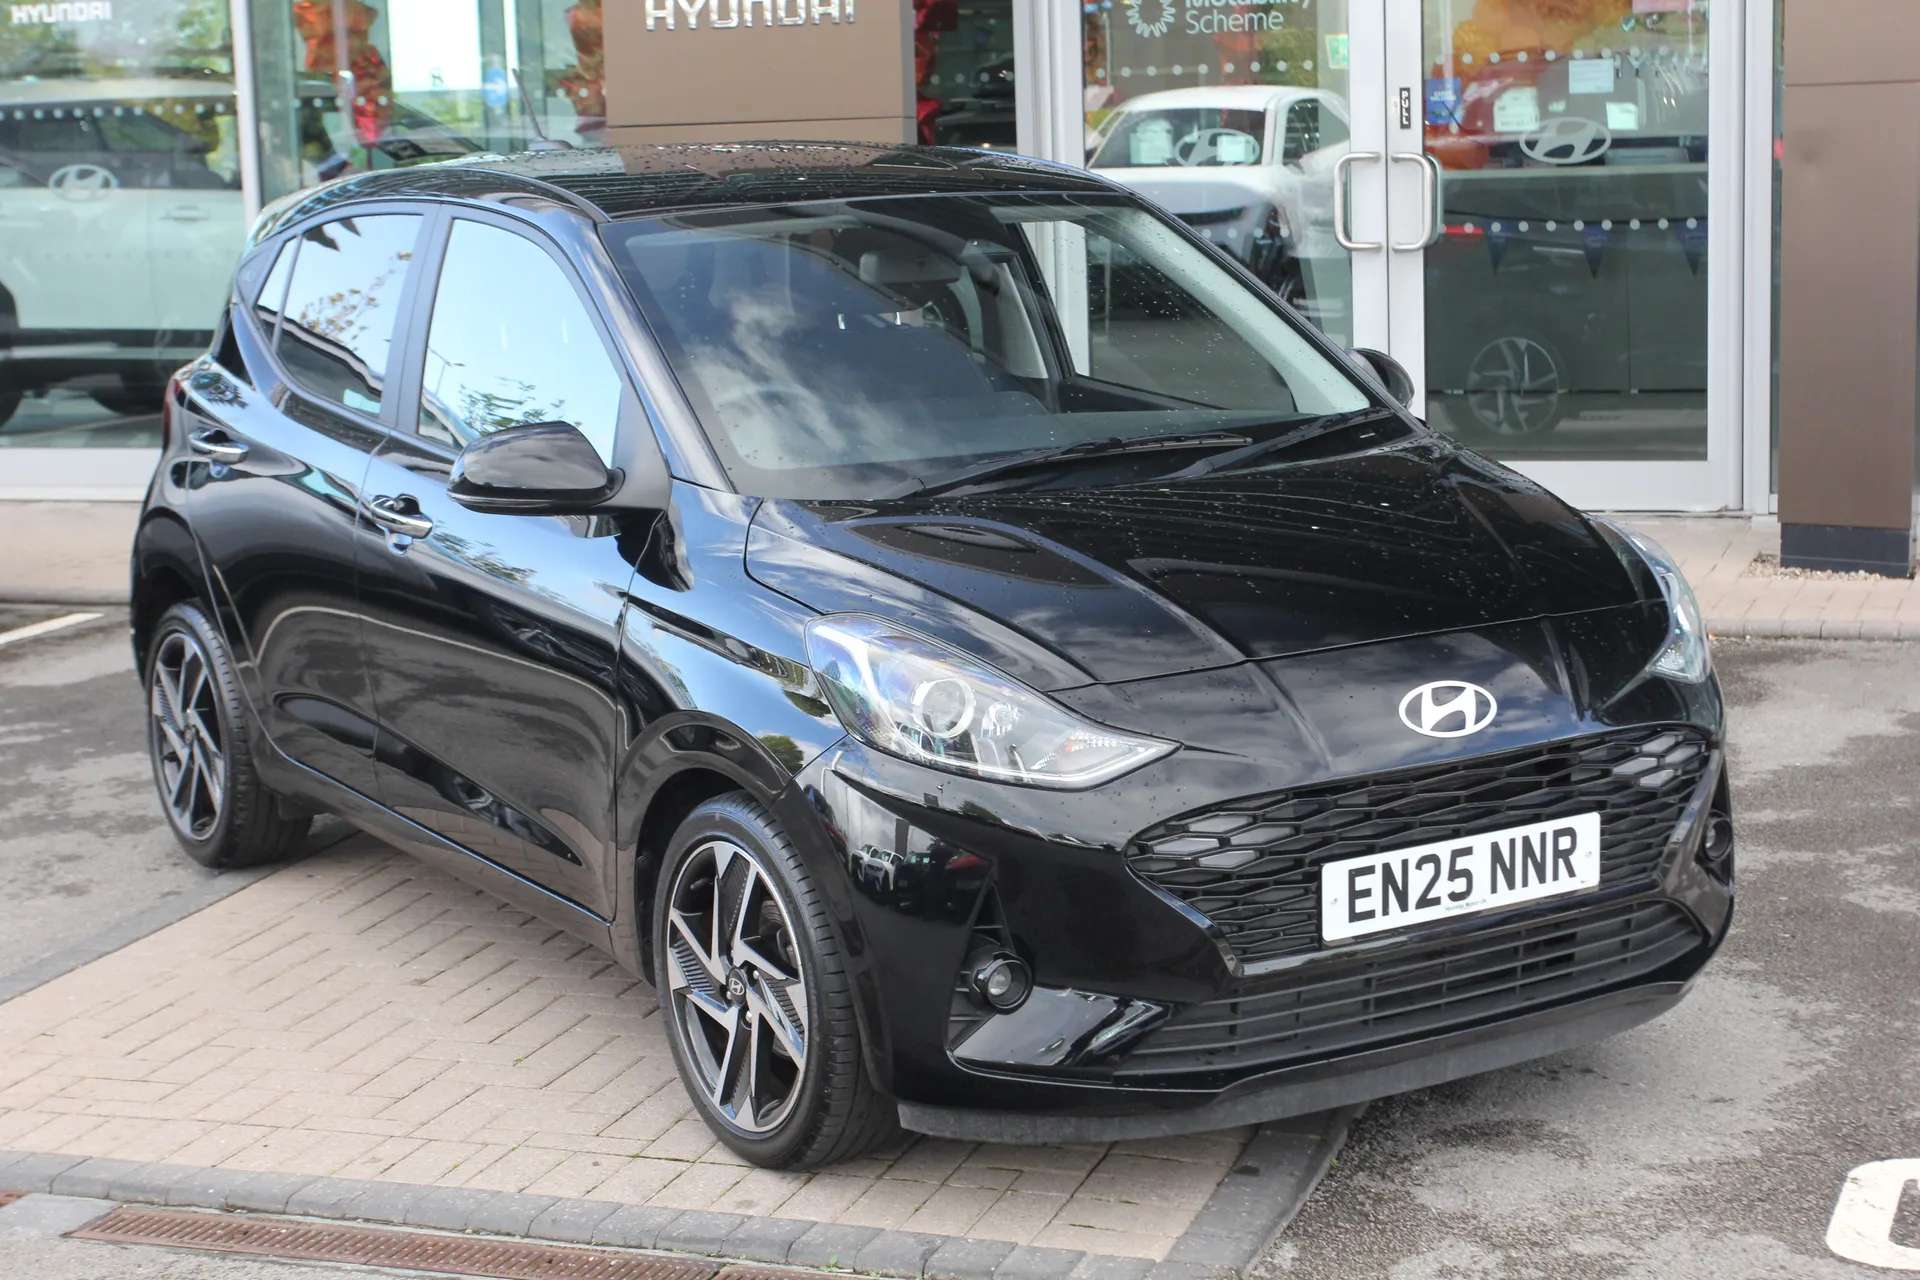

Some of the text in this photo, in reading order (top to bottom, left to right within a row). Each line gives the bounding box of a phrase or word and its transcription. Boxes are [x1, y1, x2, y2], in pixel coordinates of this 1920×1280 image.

[11, 1, 111, 24] HYUNDAI
[645, 0, 854, 31] HYUNDAI
[1186, 9, 1285, 34] Scheme
[1348, 826, 1578, 923] EN25 NNR
